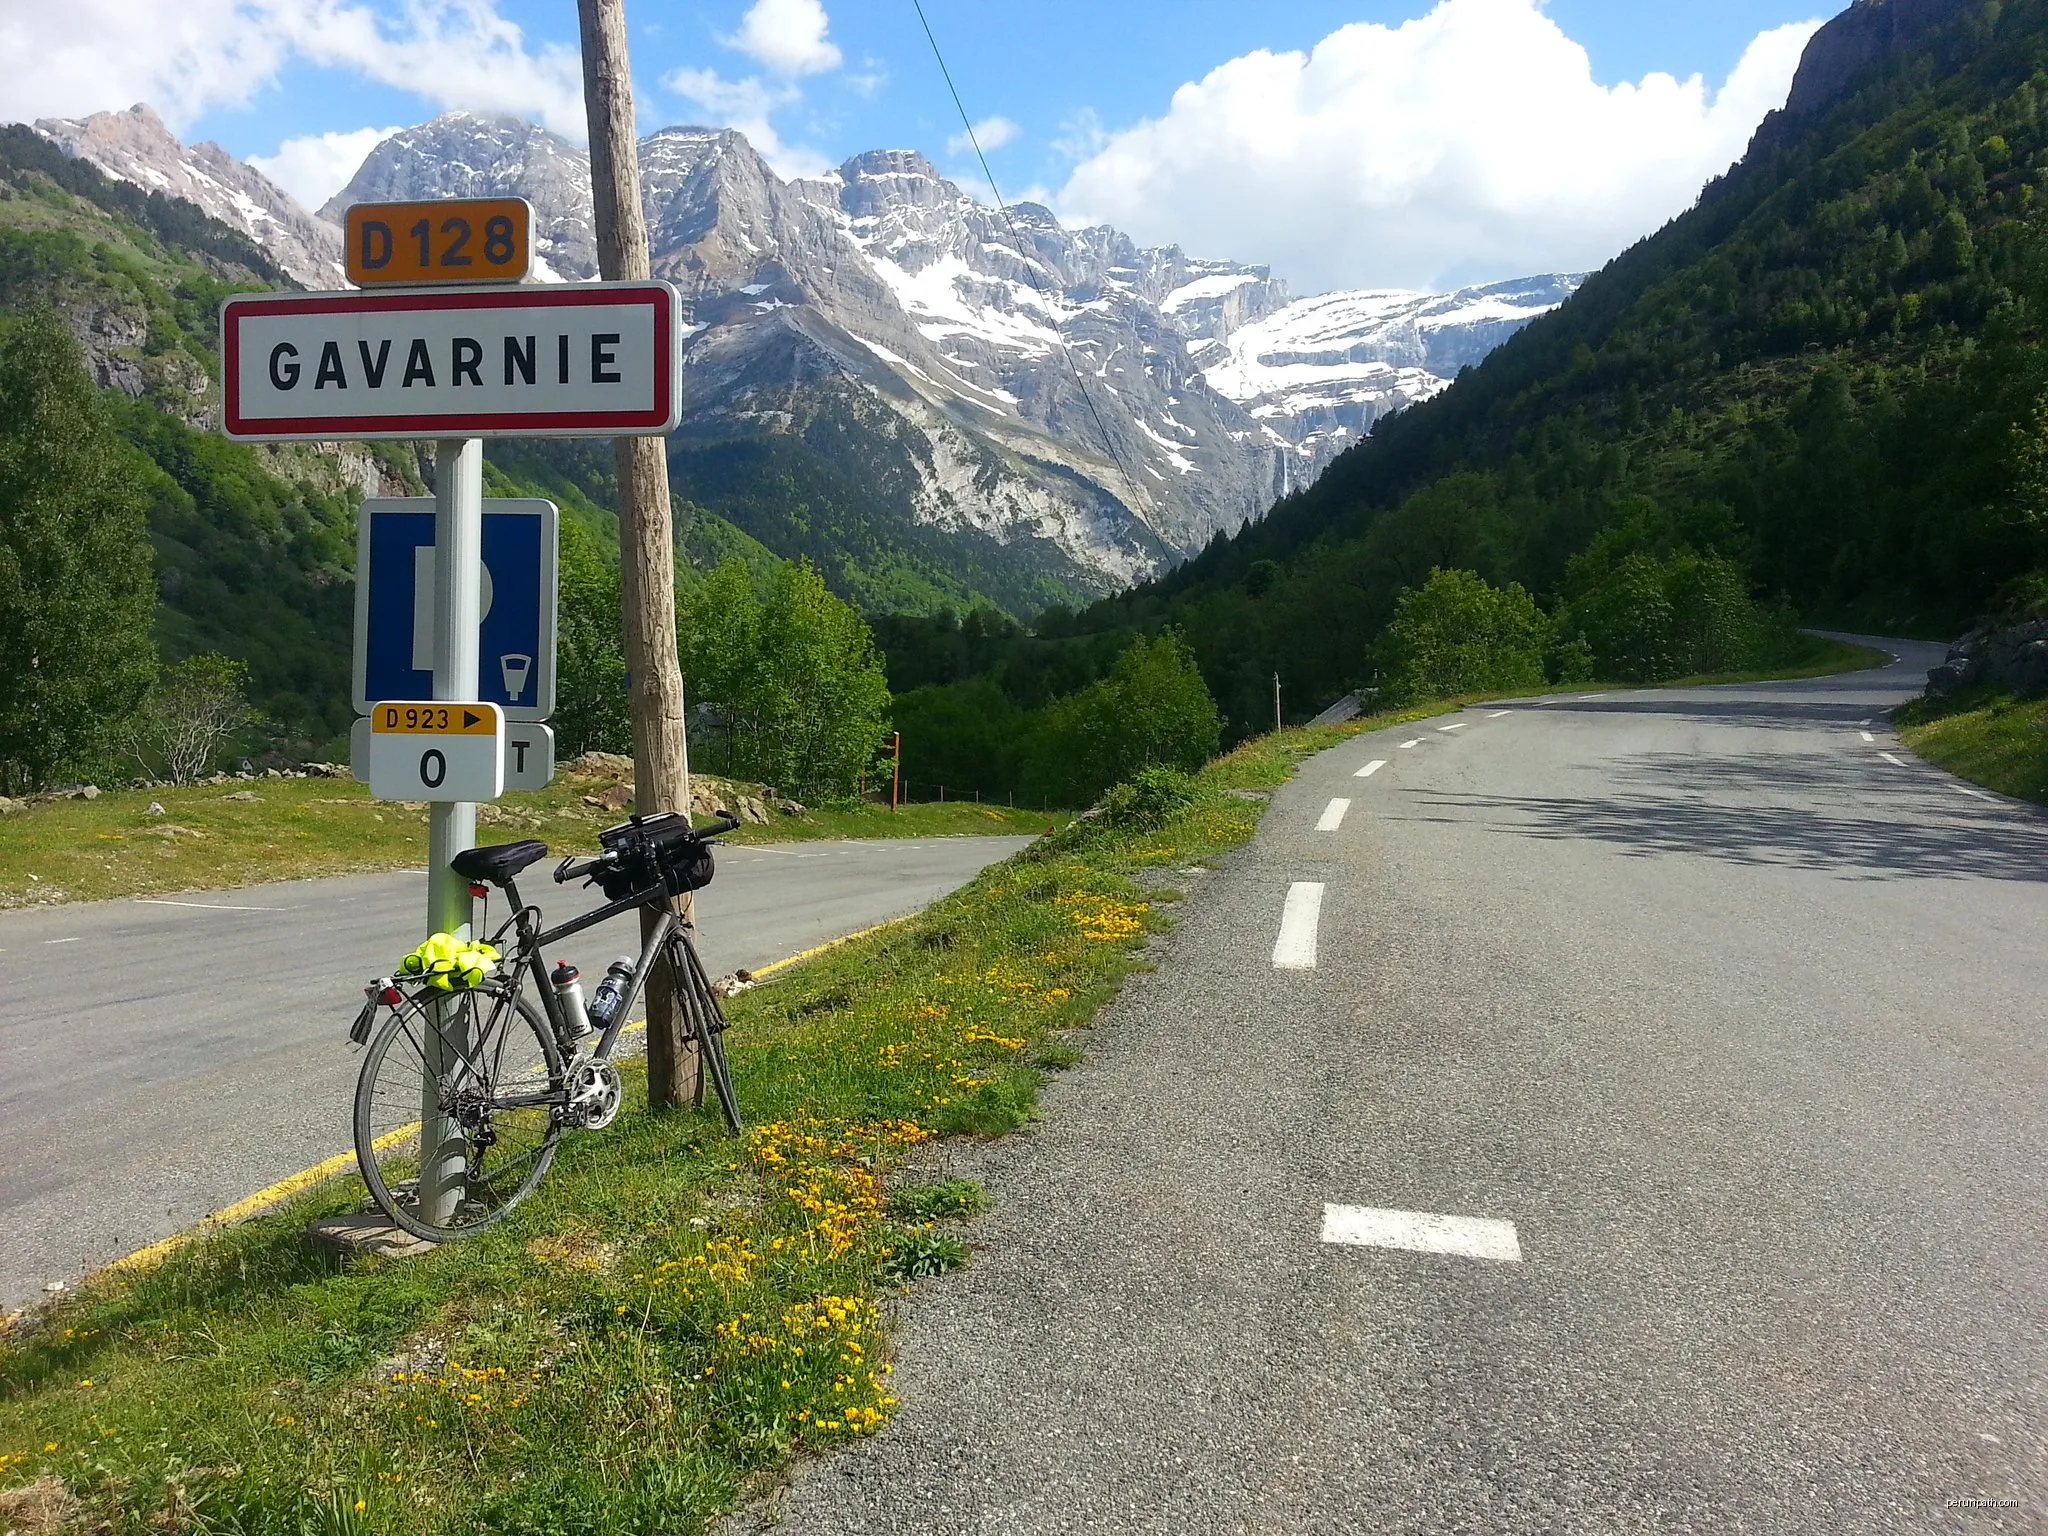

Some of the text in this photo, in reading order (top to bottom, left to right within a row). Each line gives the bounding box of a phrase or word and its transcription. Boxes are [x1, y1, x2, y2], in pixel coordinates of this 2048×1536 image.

[361, 215, 515, 270] D 128
[269, 333, 622, 391] GAVARNIE
[386, 708, 449, 730] D 923
[420, 748, 447, 789] 0
